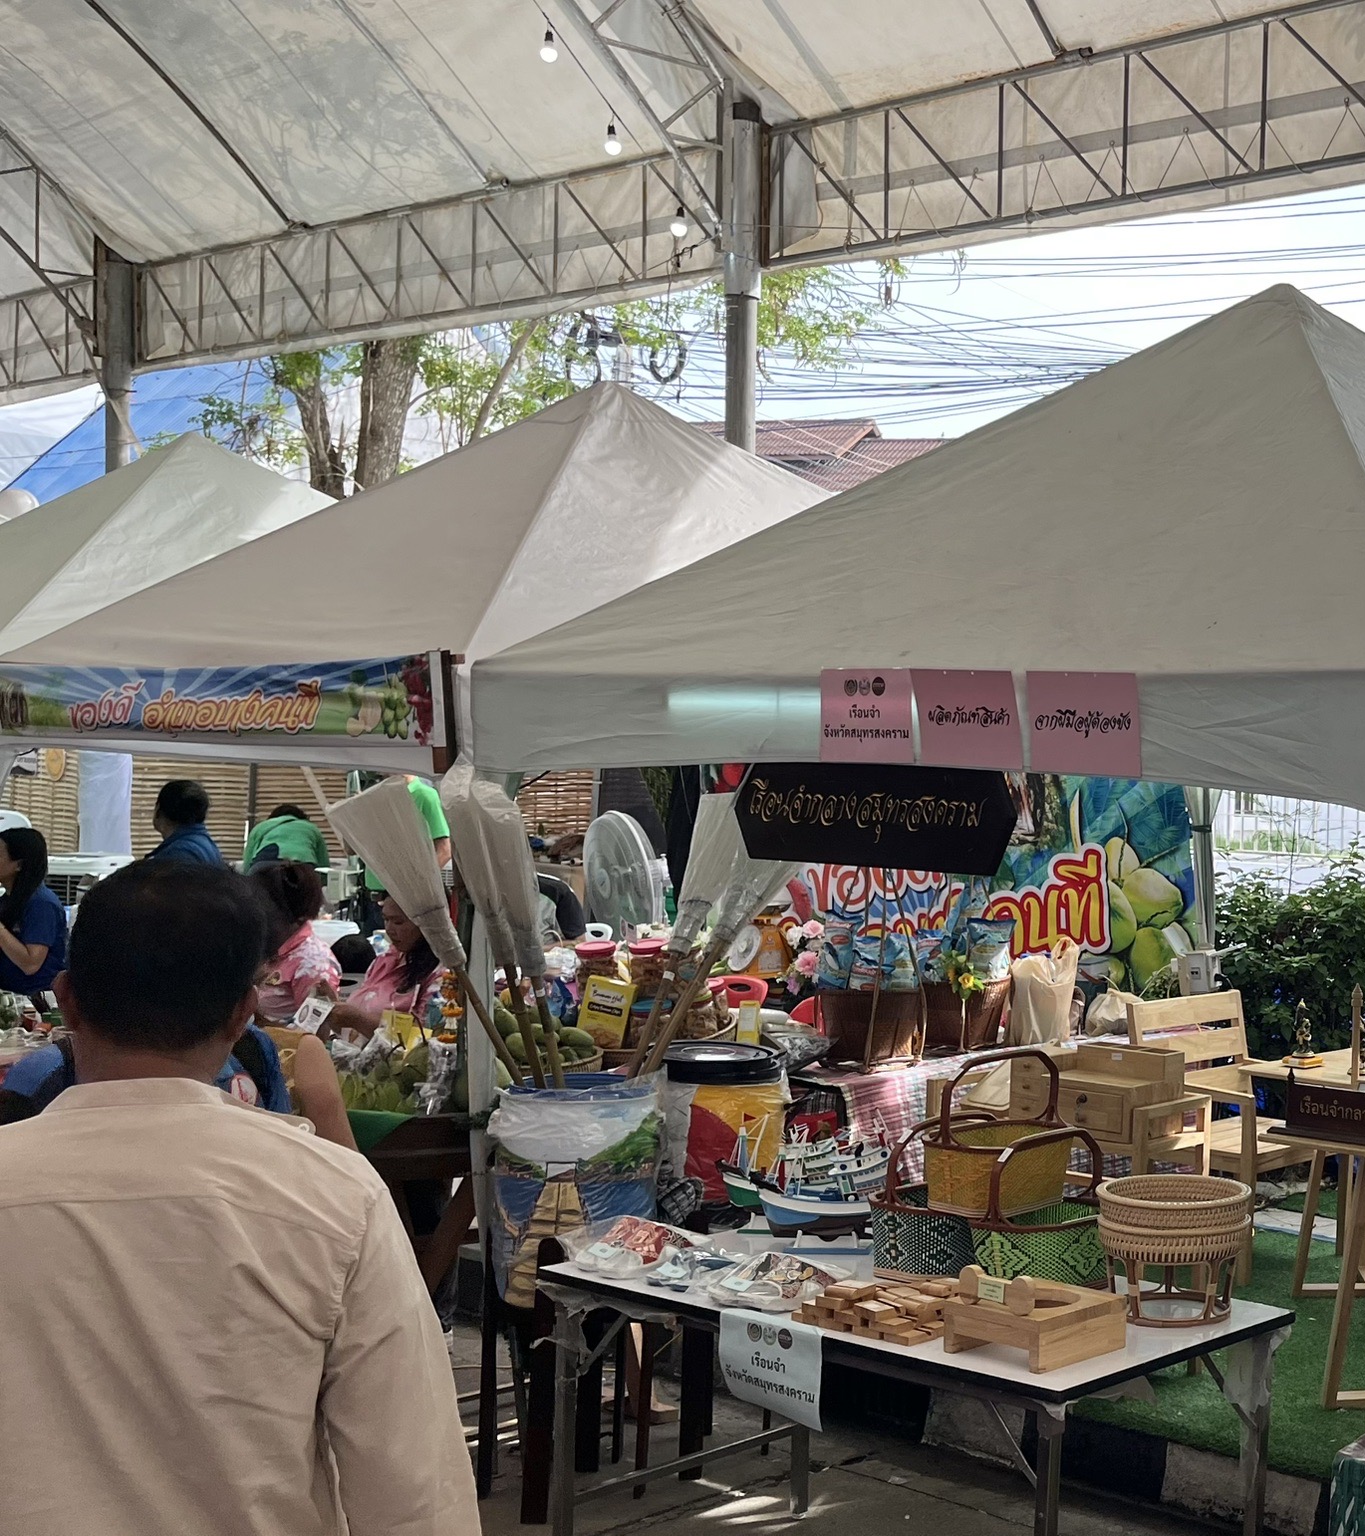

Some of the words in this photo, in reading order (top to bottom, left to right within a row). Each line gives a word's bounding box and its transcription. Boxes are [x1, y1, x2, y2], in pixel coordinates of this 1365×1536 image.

[68, 680, 145, 732] ของดี
[142, 676, 322, 737] อำเภอบางคนที
[849, 705, 881, 719] เรือนจำ
[928, 705, 1010, 727] ผลิตภัณฑ์สินค้า
[823, 724, 910, 742] จังหวัดสมุทรสงคราม
[1034, 709, 1132, 738] จากฝีมือผู้ต้องขัง
[750, 778, 990, 844] เรือนจำกลางสมุทรสงคราม
[751, 1351, 786, 1374] เรือนจำ
[725, 1364, 815, 1403] จังหวัดสมุทรสงคราม
